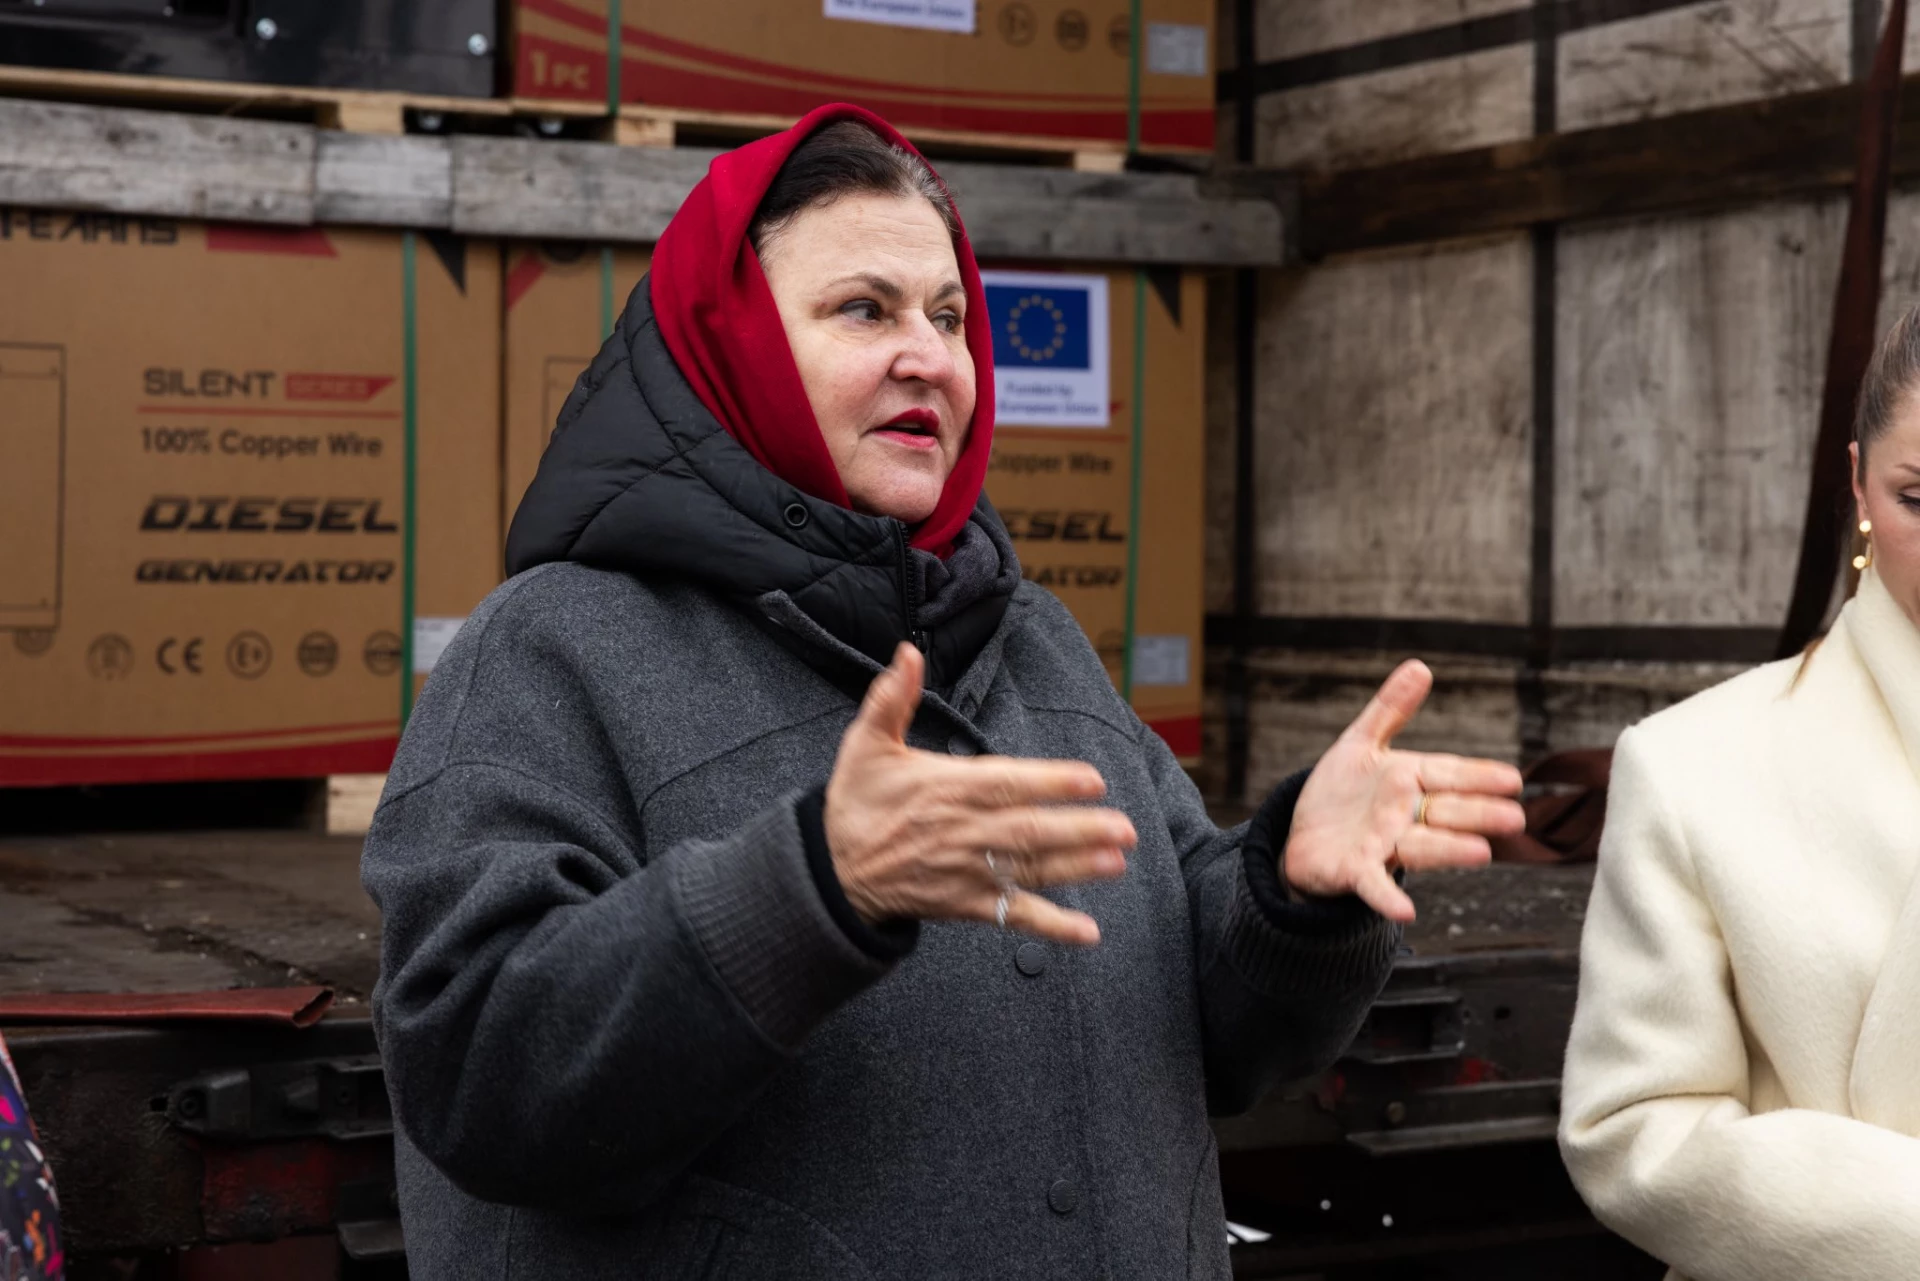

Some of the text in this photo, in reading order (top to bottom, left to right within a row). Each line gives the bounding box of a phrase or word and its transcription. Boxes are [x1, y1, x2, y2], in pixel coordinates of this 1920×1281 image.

[530, 51, 546, 86] 1
[143, 367, 276, 398] SILENT
[141, 427, 383, 460] 100% Copper Wire
[1069, 453, 1113, 472] Wire
[139, 495, 399, 533] DIESEL
[134, 558, 396, 585] GENERATOR
